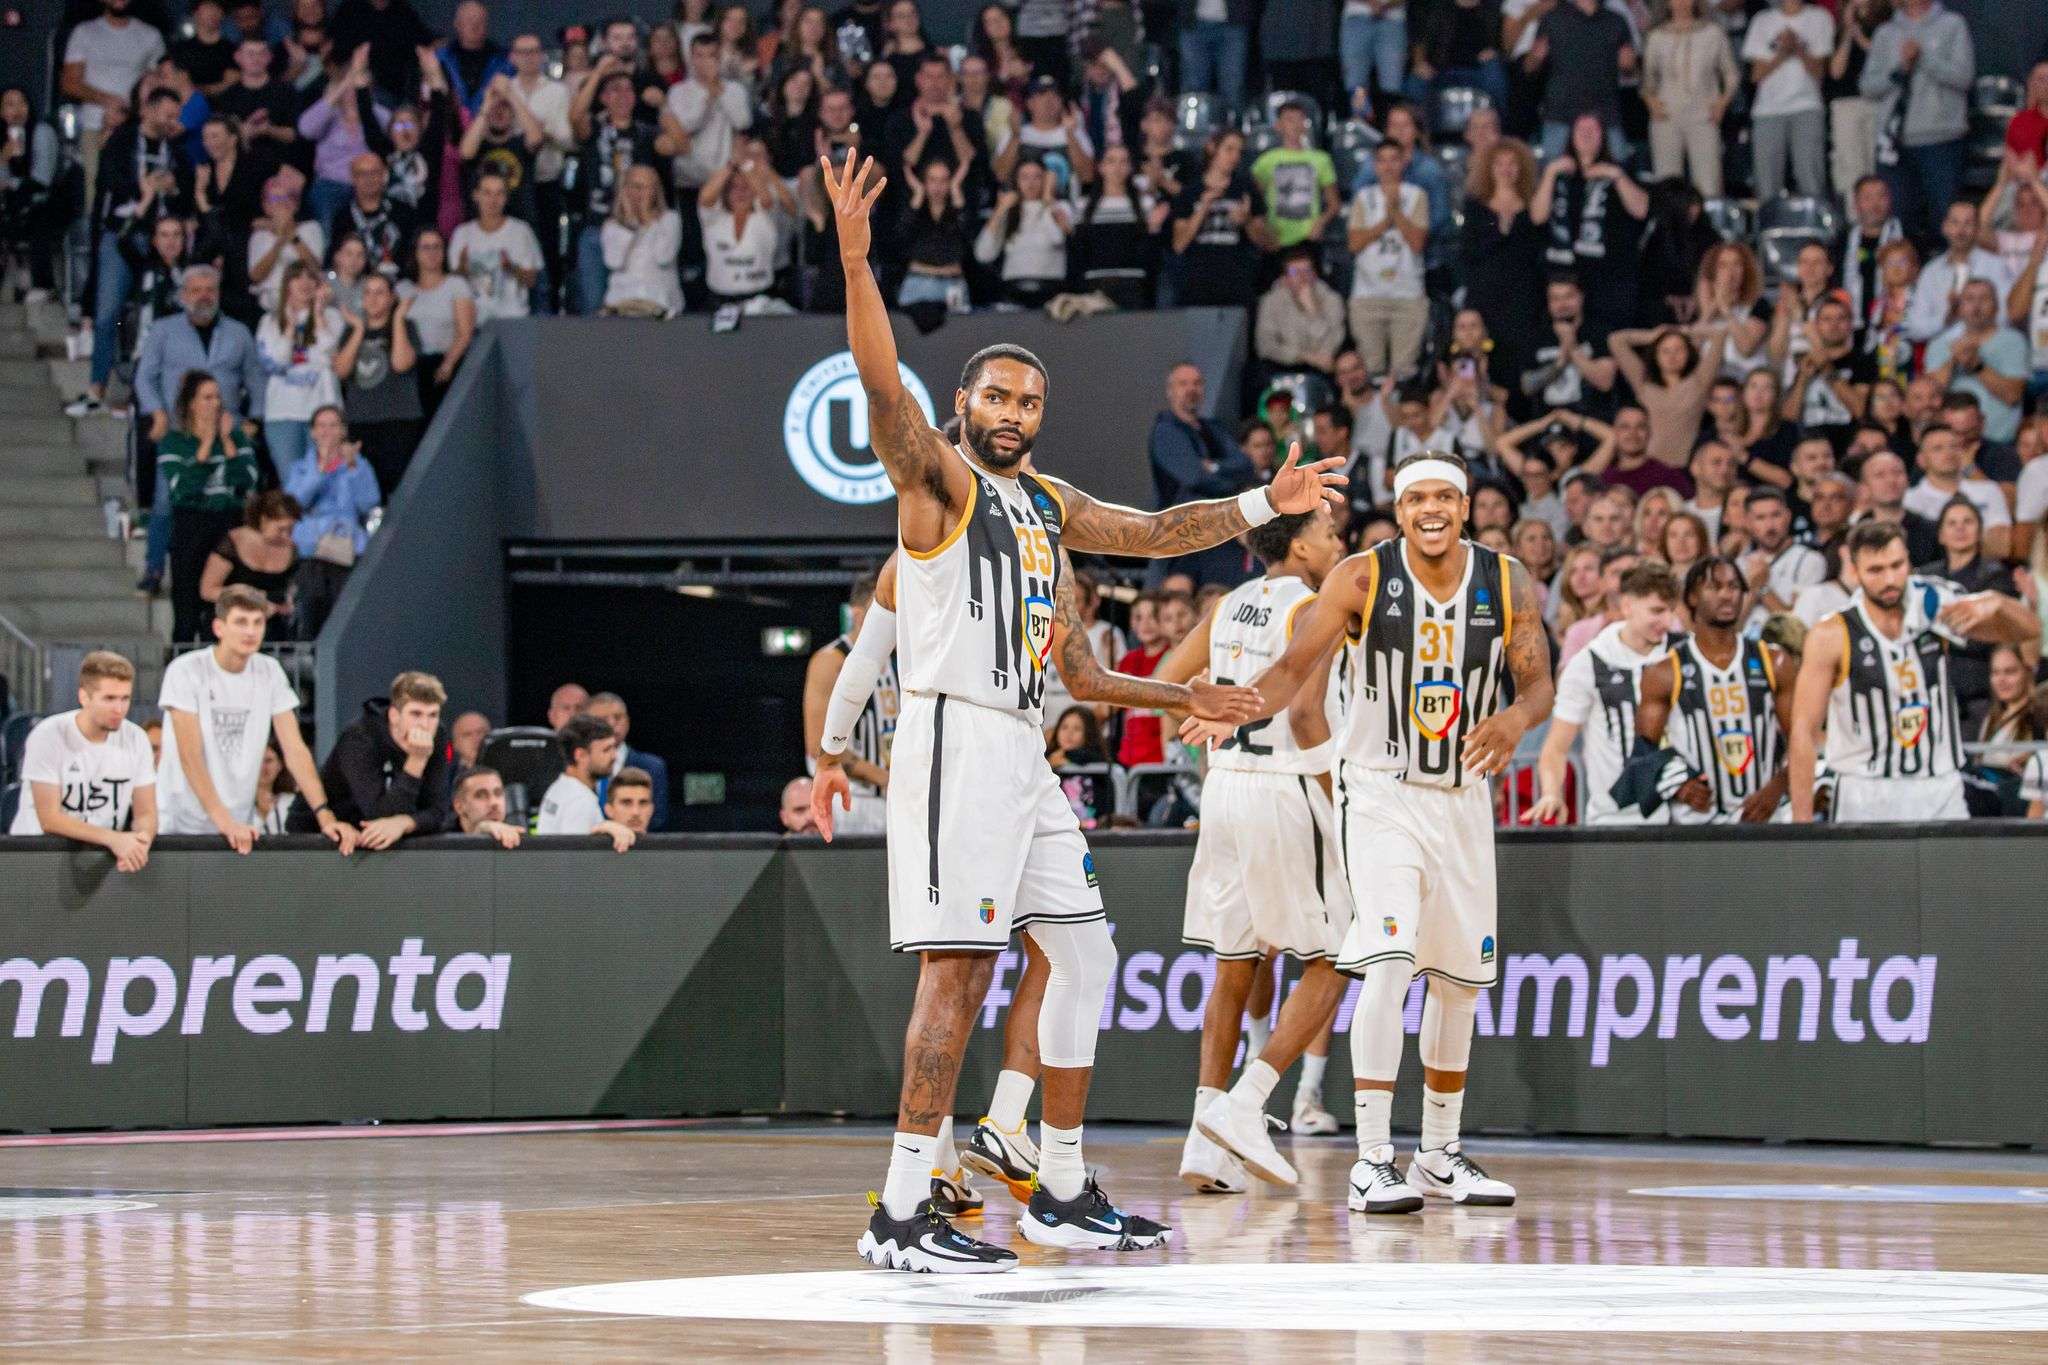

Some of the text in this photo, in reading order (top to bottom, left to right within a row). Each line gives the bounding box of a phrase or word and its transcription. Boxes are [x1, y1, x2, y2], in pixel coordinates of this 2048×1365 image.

[1016, 527, 1052, 576] 35
[1031, 614, 1050, 639] BT
[1419, 621, 1454, 664] 31
[1422, 695, 1451, 714] BT
[1709, 684, 1746, 717] 95
[0, 938, 512, 1065] mprenta
